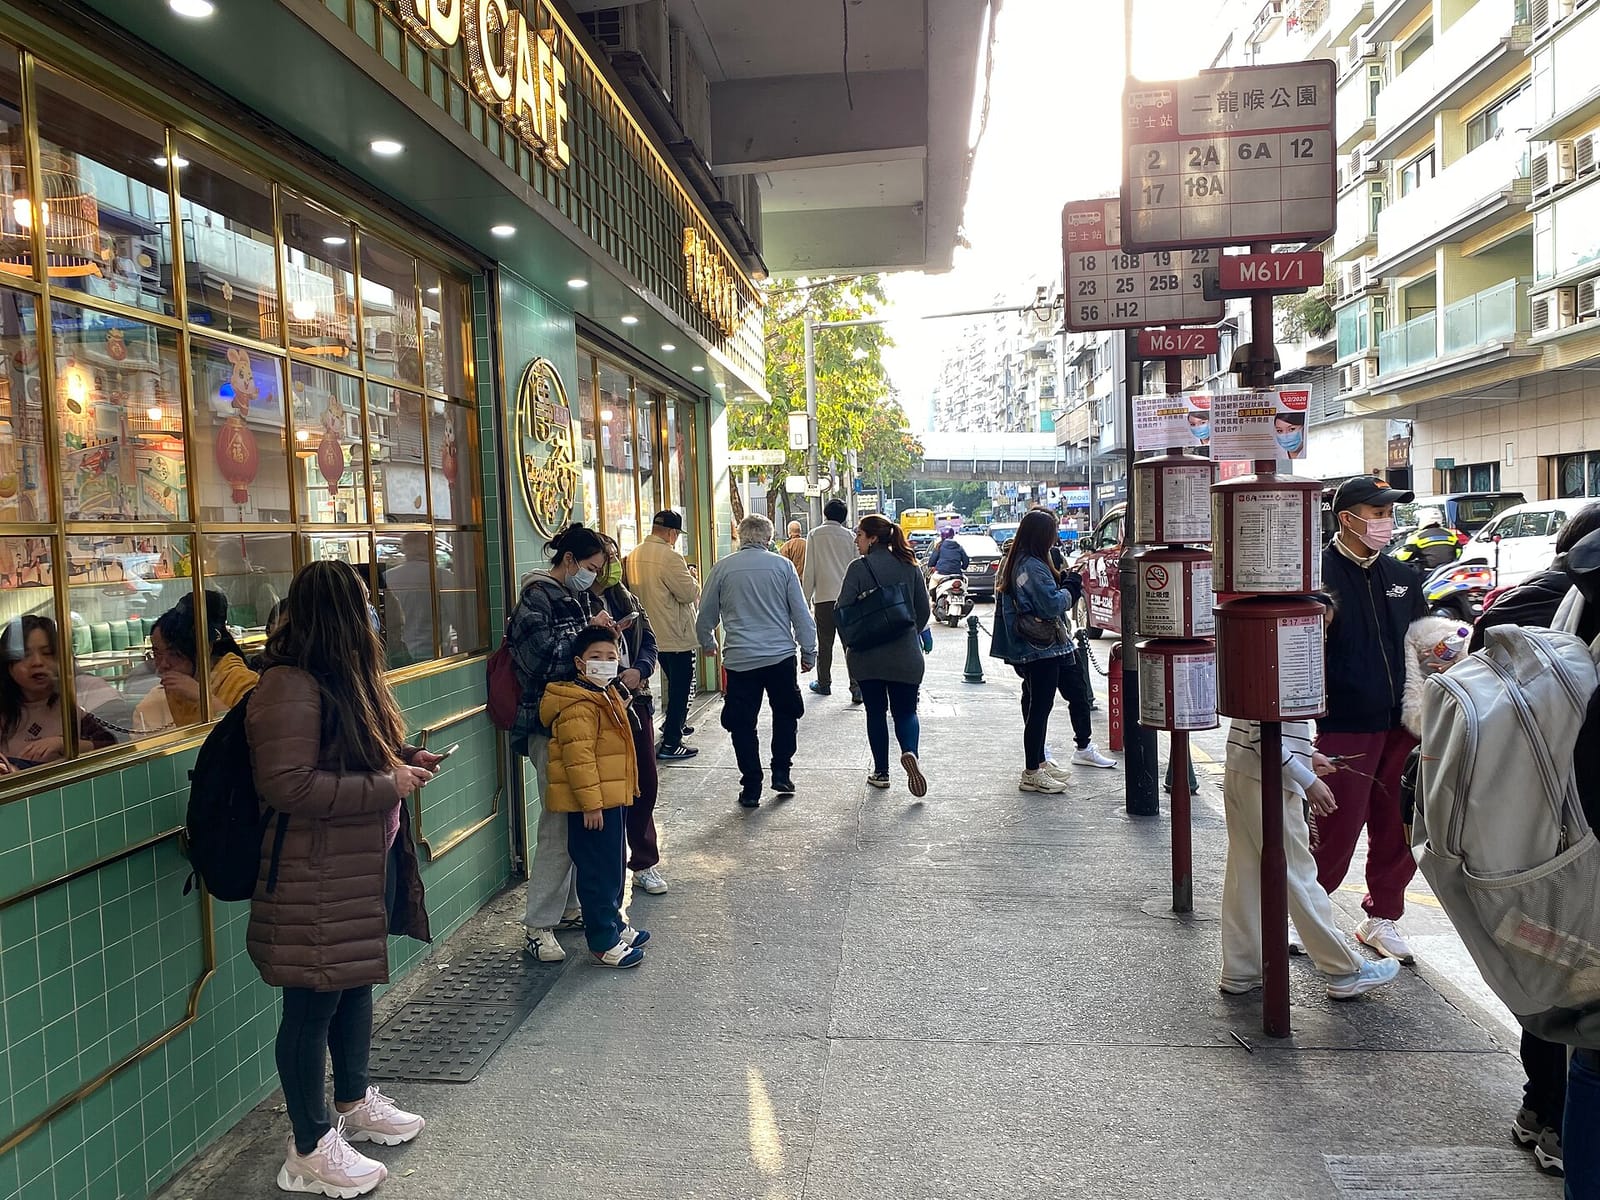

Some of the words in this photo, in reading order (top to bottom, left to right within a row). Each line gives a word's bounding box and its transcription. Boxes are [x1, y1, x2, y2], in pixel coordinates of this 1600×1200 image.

[1191, 84, 1318, 114] 二龍喉公園
[1128, 114, 1173, 129] 巴士站
[1147, 150, 1161, 170] 2
[1188, 145, 1221, 167] 2A
[1237, 142, 1272, 160] 6A
[1290, 138, 1314, 159] 12
[1142, 183, 1165, 205] 17
[1184, 176, 1224, 198] 18A
[1067, 230, 1102, 242] 巴士站
[1078, 255, 1096, 271] 18
[1111, 254, 1141, 270] 18B
[1152, 251, 1171, 266] 19
[1191, 249, 1210, 264] 22
[1240, 259, 1304, 282] M61/1
[1078, 280, 1097, 296] 23
[1116, 277, 1135, 294] 25
[1150, 275, 1179, 291] 25B
[1192, 274, 1201, 289] 3
[1080, 305, 1099, 321] 56
[1115, 302, 1139, 318] H2
[1150, 333, 1205, 351] M61/2
[1112, 683, 1120, 730] 3090
